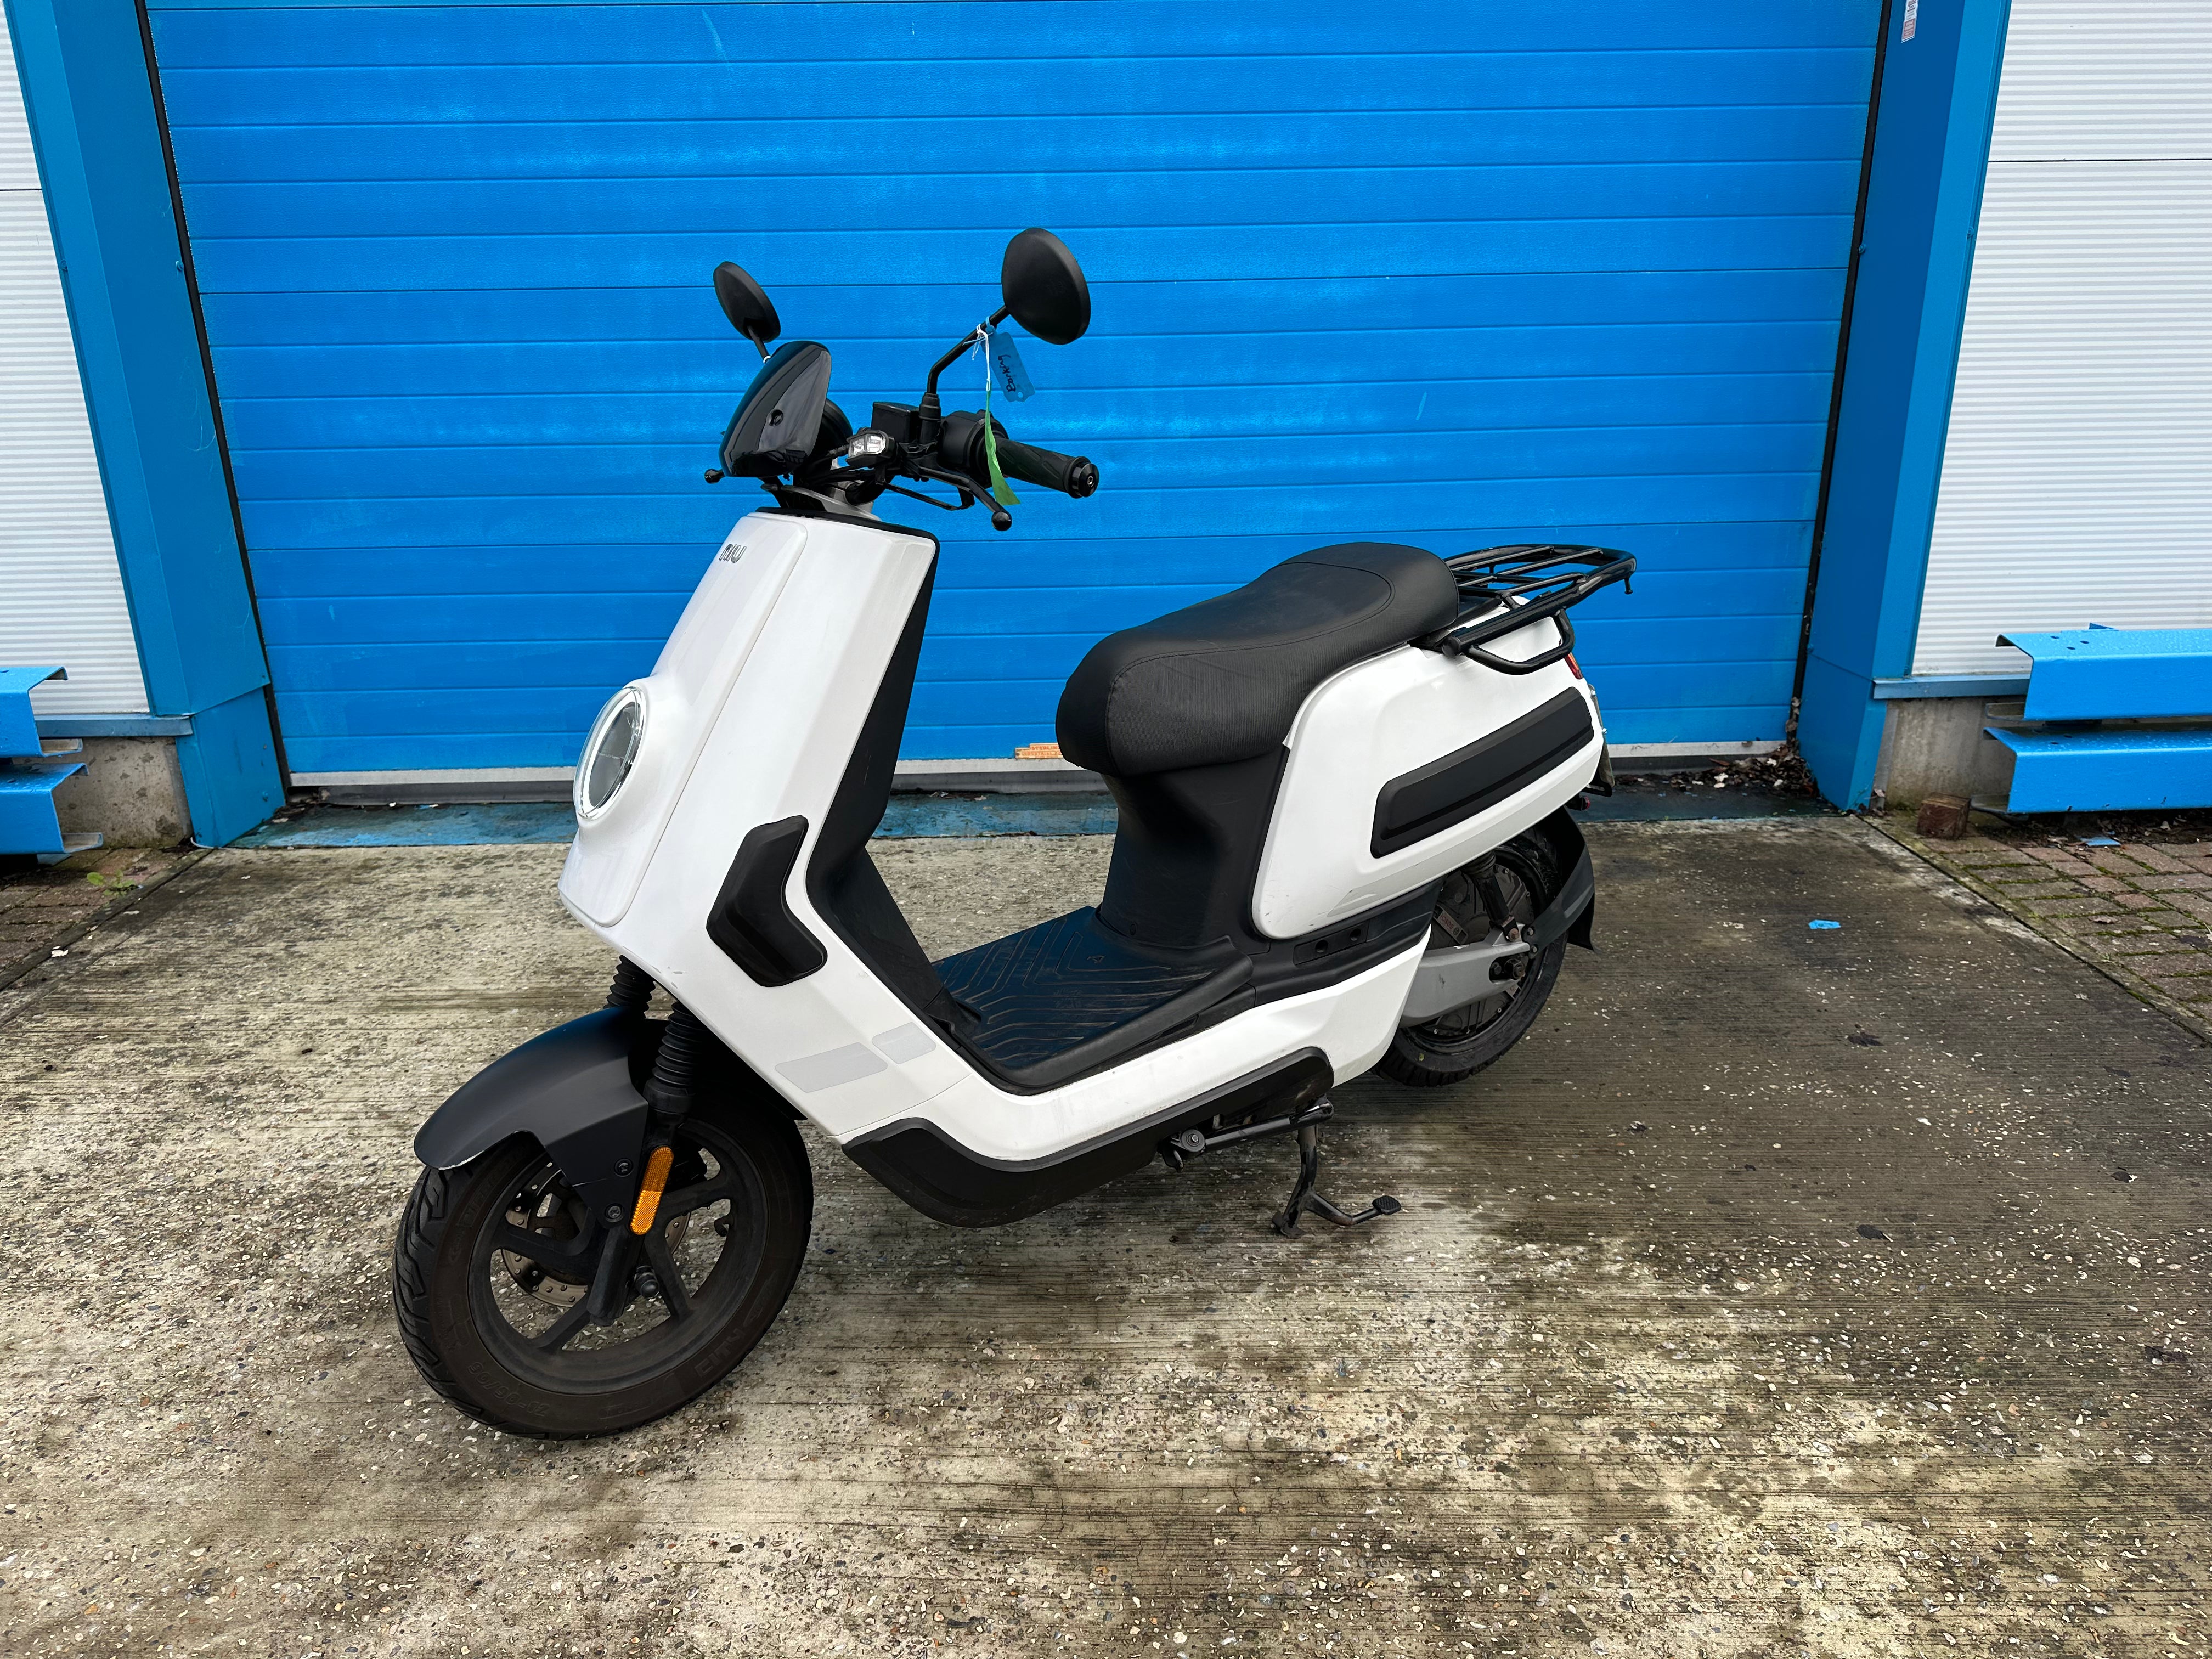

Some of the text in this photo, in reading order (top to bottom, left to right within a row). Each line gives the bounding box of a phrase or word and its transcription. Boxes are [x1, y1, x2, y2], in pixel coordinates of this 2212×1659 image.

[719, 543, 747, 563] NIU
[694, 1328, 746, 1378] CITY
[467, 1362, 550, 1417] 90/90-12
